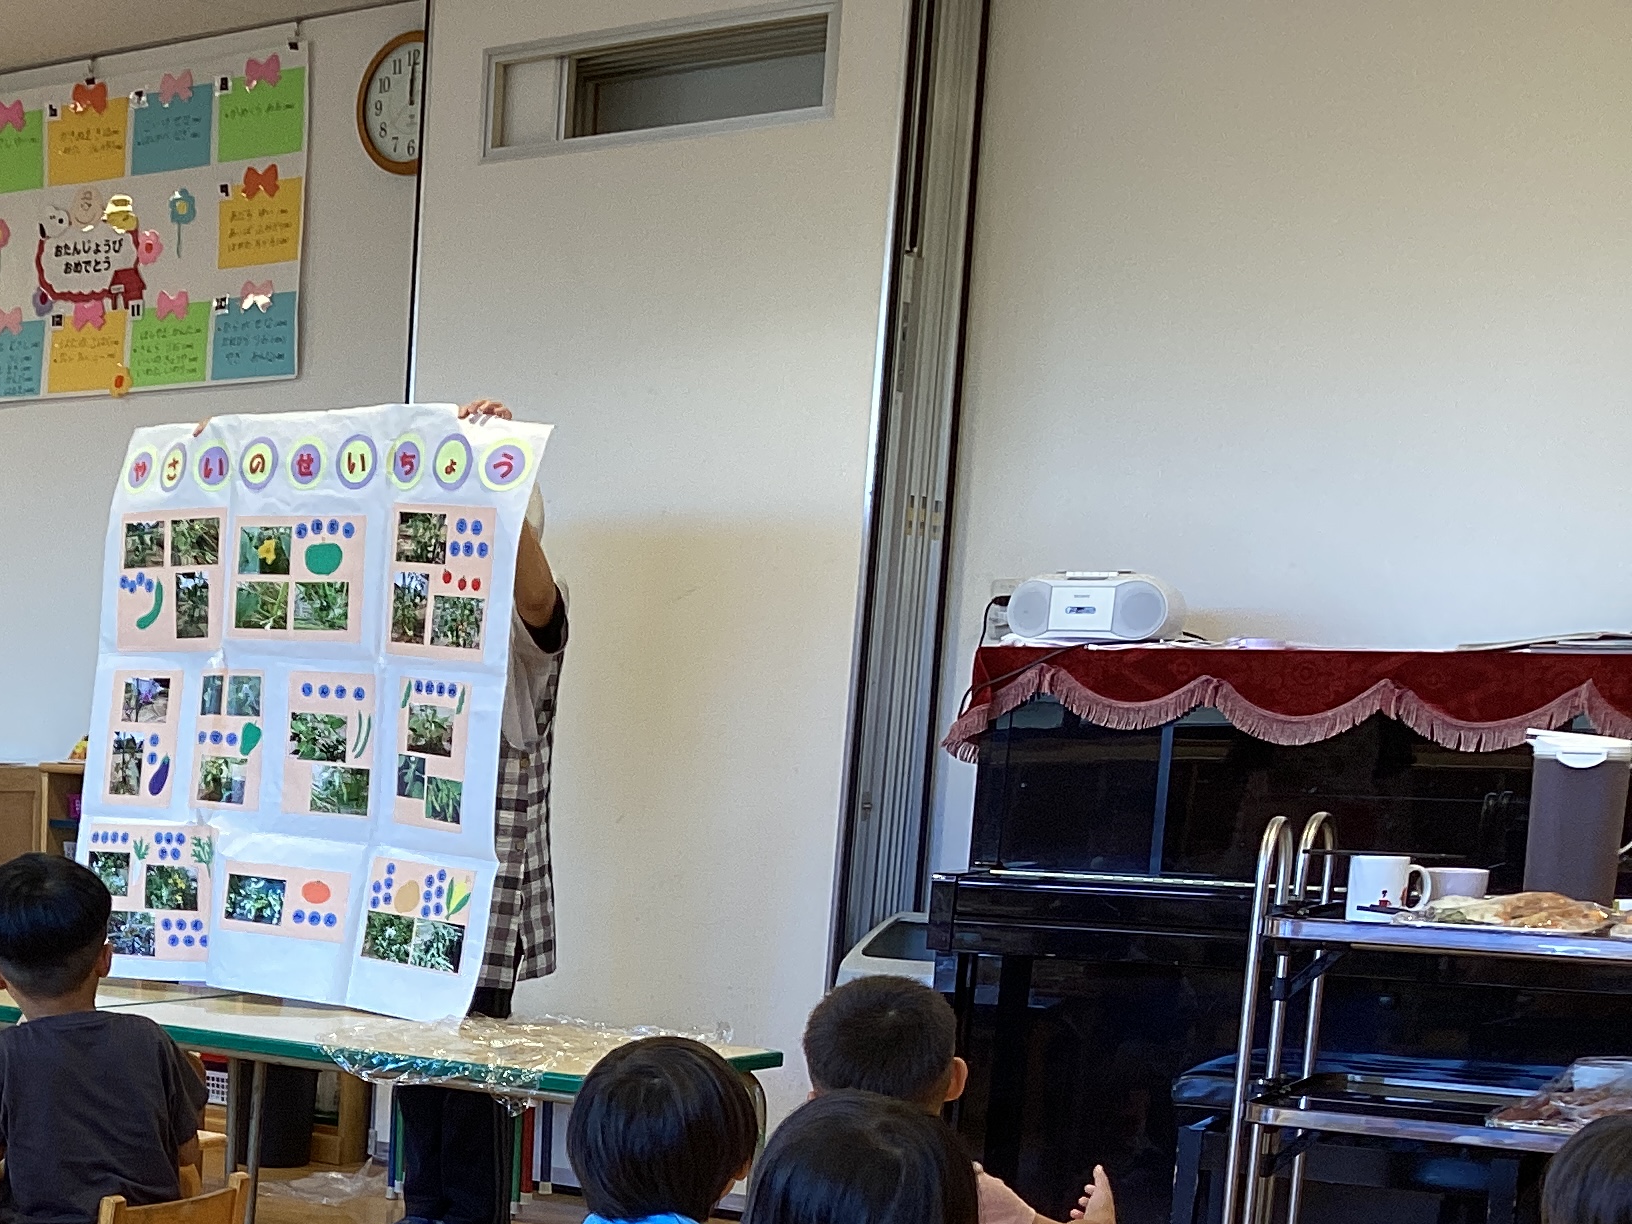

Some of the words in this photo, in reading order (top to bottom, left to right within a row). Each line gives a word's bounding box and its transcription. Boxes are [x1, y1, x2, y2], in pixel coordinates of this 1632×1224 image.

[408, 49, 420, 66] 12
[392, 59, 402, 75] 11
[378, 76, 390, 93] 10
[374, 100, 382, 116] 9
[379, 122, 387, 138] 8
[392, 136, 399, 152] 7
[407, 139, 415, 156] 6
[54, 238, 123, 257] おたんじょうび
[64, 256, 111, 274] おめでとう
[131, 304, 141, 317] 11
[133, 450, 515, 481] やさいのせいちょう
